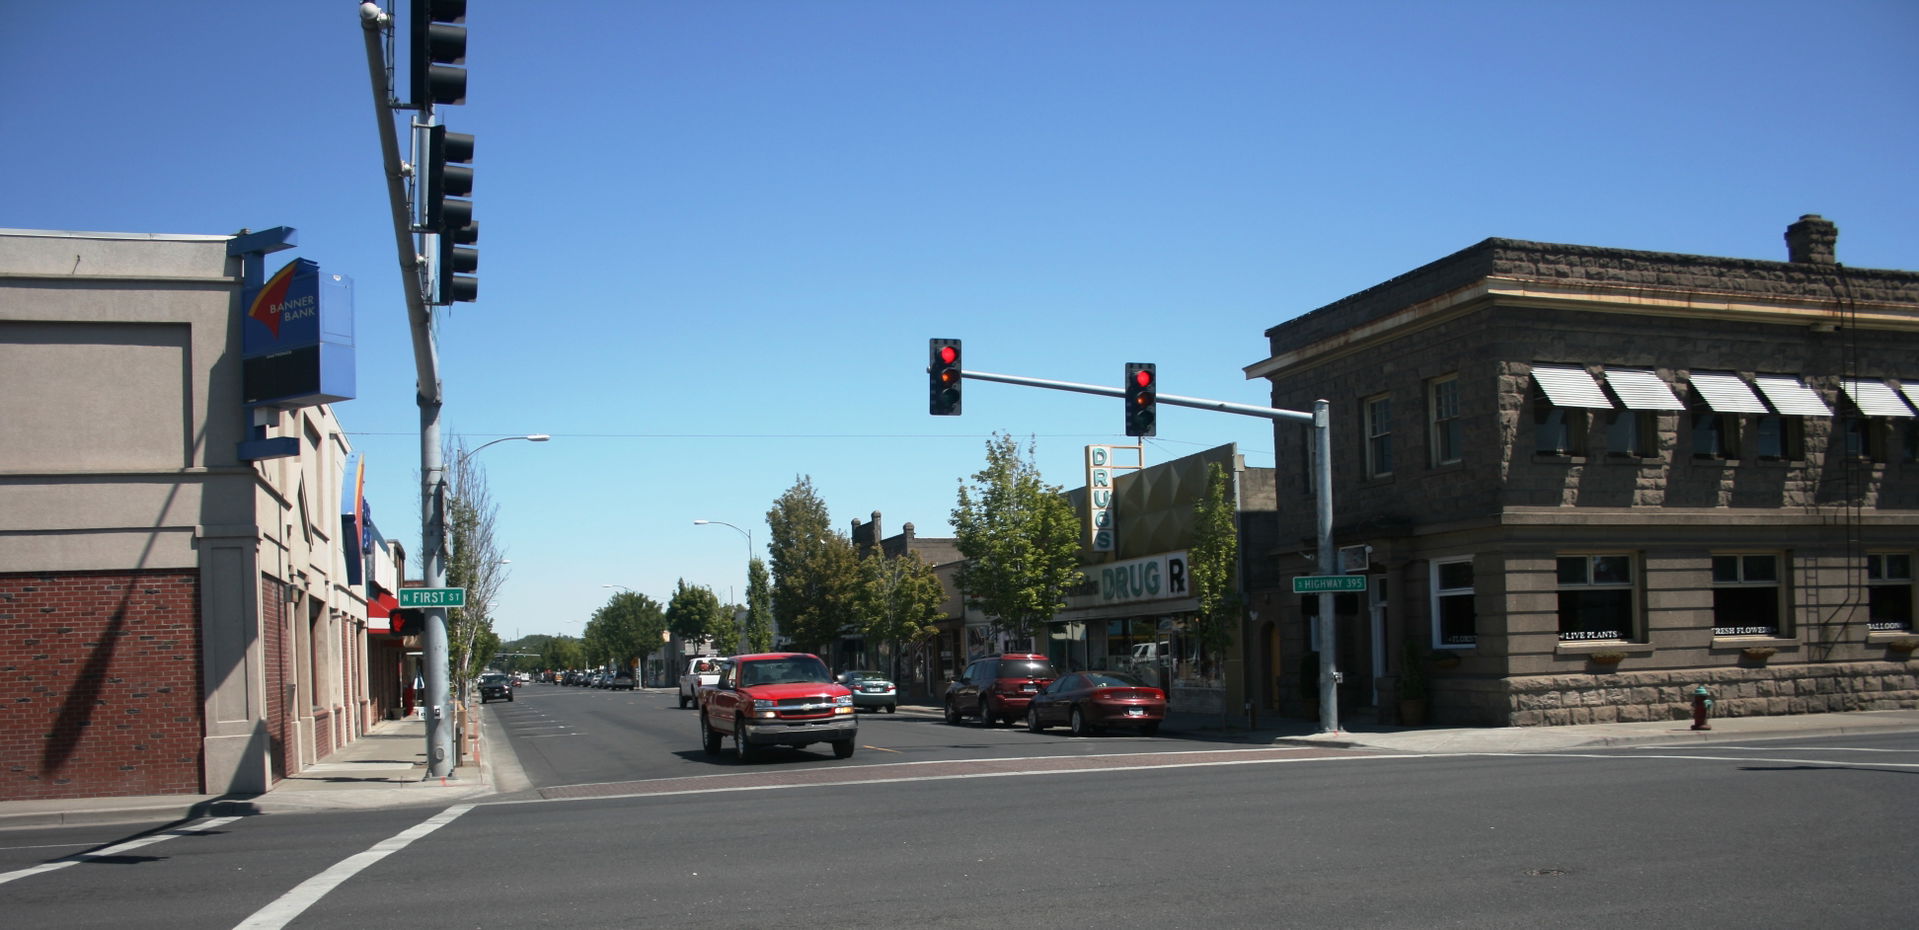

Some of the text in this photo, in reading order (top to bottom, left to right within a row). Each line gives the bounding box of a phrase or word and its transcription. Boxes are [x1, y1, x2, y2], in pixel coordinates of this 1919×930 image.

[269, 296, 314, 314] BANNER
[284, 308, 316, 321] BANK
[1093, 447, 1110, 548] DRUGS
[1102, 561, 1160, 601] DRUG
[1304, 579, 1343, 590] HIGHWAY
[1346, 578, 1363, 588] 395
[403, 591, 460, 603] N FIRST ST
[1565, 630, 1618, 640] LIVE PLANTS
